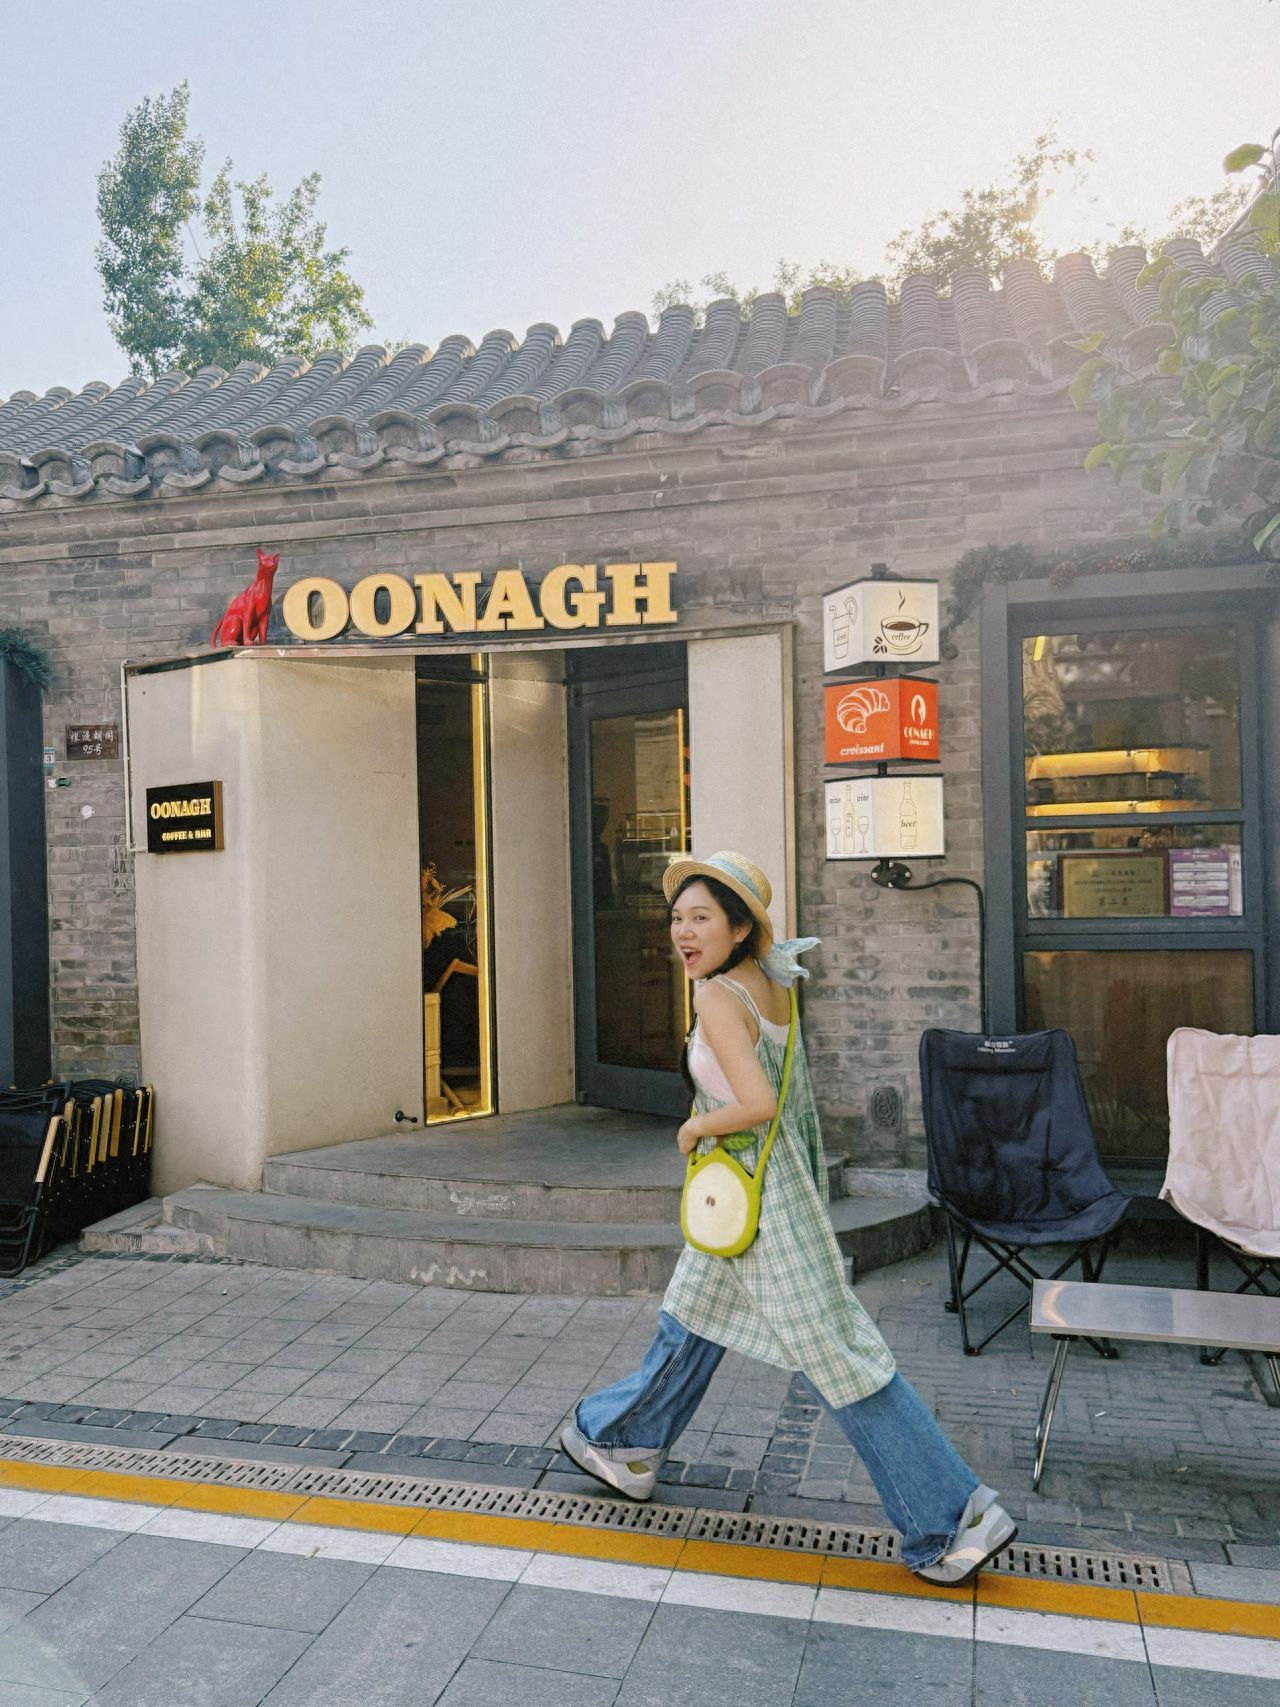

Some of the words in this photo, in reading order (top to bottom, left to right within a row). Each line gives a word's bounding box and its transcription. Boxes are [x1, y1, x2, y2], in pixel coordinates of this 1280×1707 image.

[282, 560, 678, 642] OONAGH
[891, 633, 911, 642] coffee
[82, 743, 103, 756] 95号
[840, 742, 885, 756] croissant
[150, 798, 211, 819] OONAGH
[900, 818, 917, 828] beer
[161, 831, 187, 842] COFFEE
[188, 830, 194, 840] &
[195, 828, 212, 840] BAR
